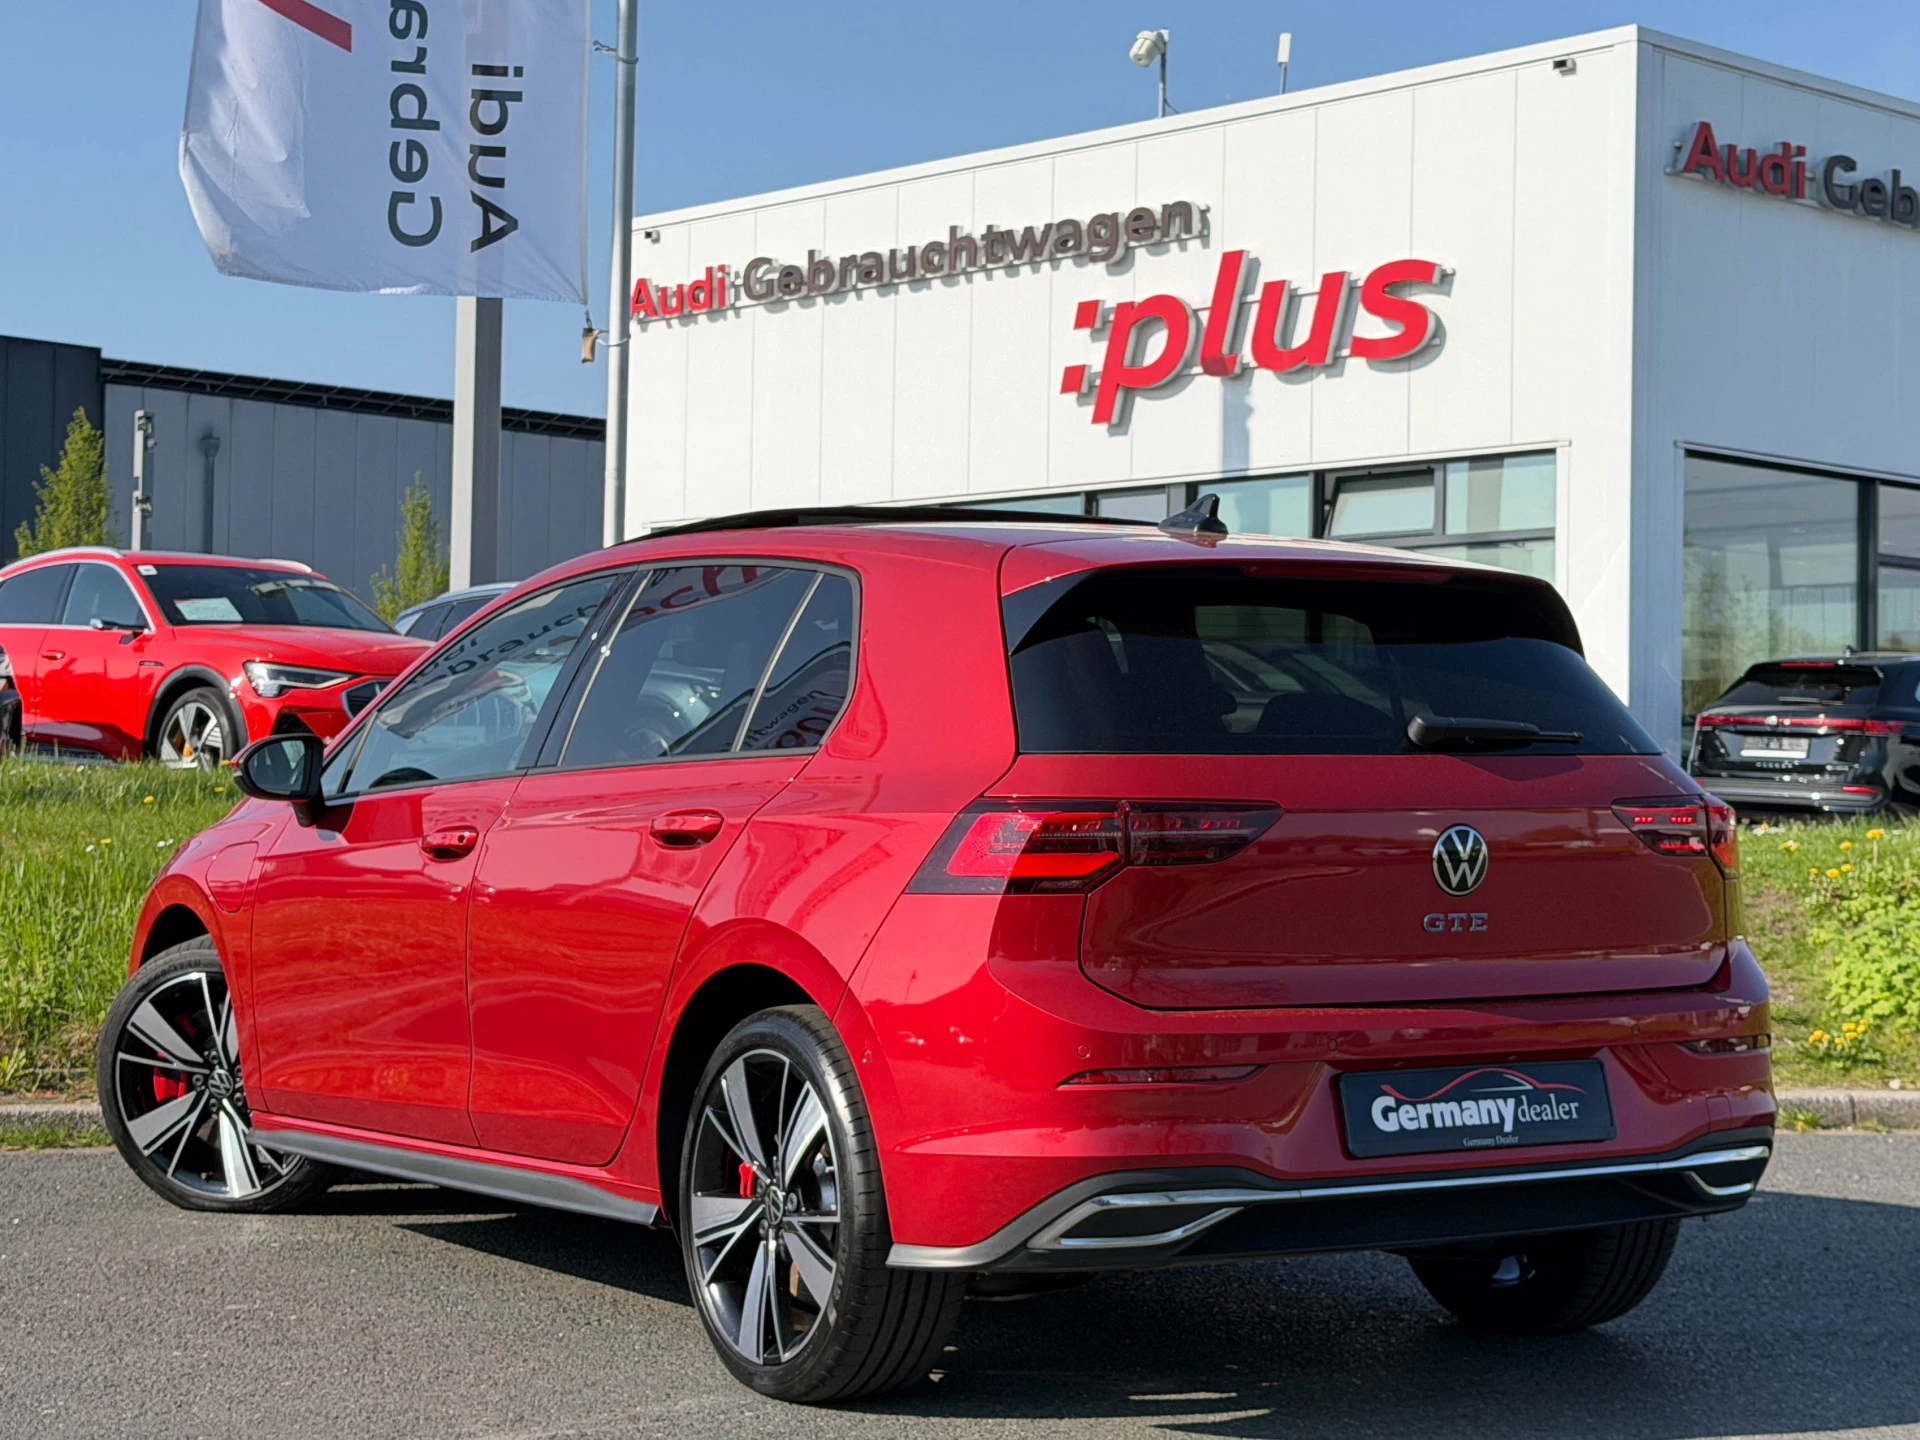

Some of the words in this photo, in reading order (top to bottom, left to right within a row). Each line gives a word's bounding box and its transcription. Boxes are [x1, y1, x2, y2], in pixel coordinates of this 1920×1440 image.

[1683, 120, 1807, 200] Audi
[1823, 154, 1919, 225] Geb
[629, 263, 727, 319] Audi
[743, 200, 1196, 300] Gebrauchtwagen
[1423, 912, 1489, 933] GTE
